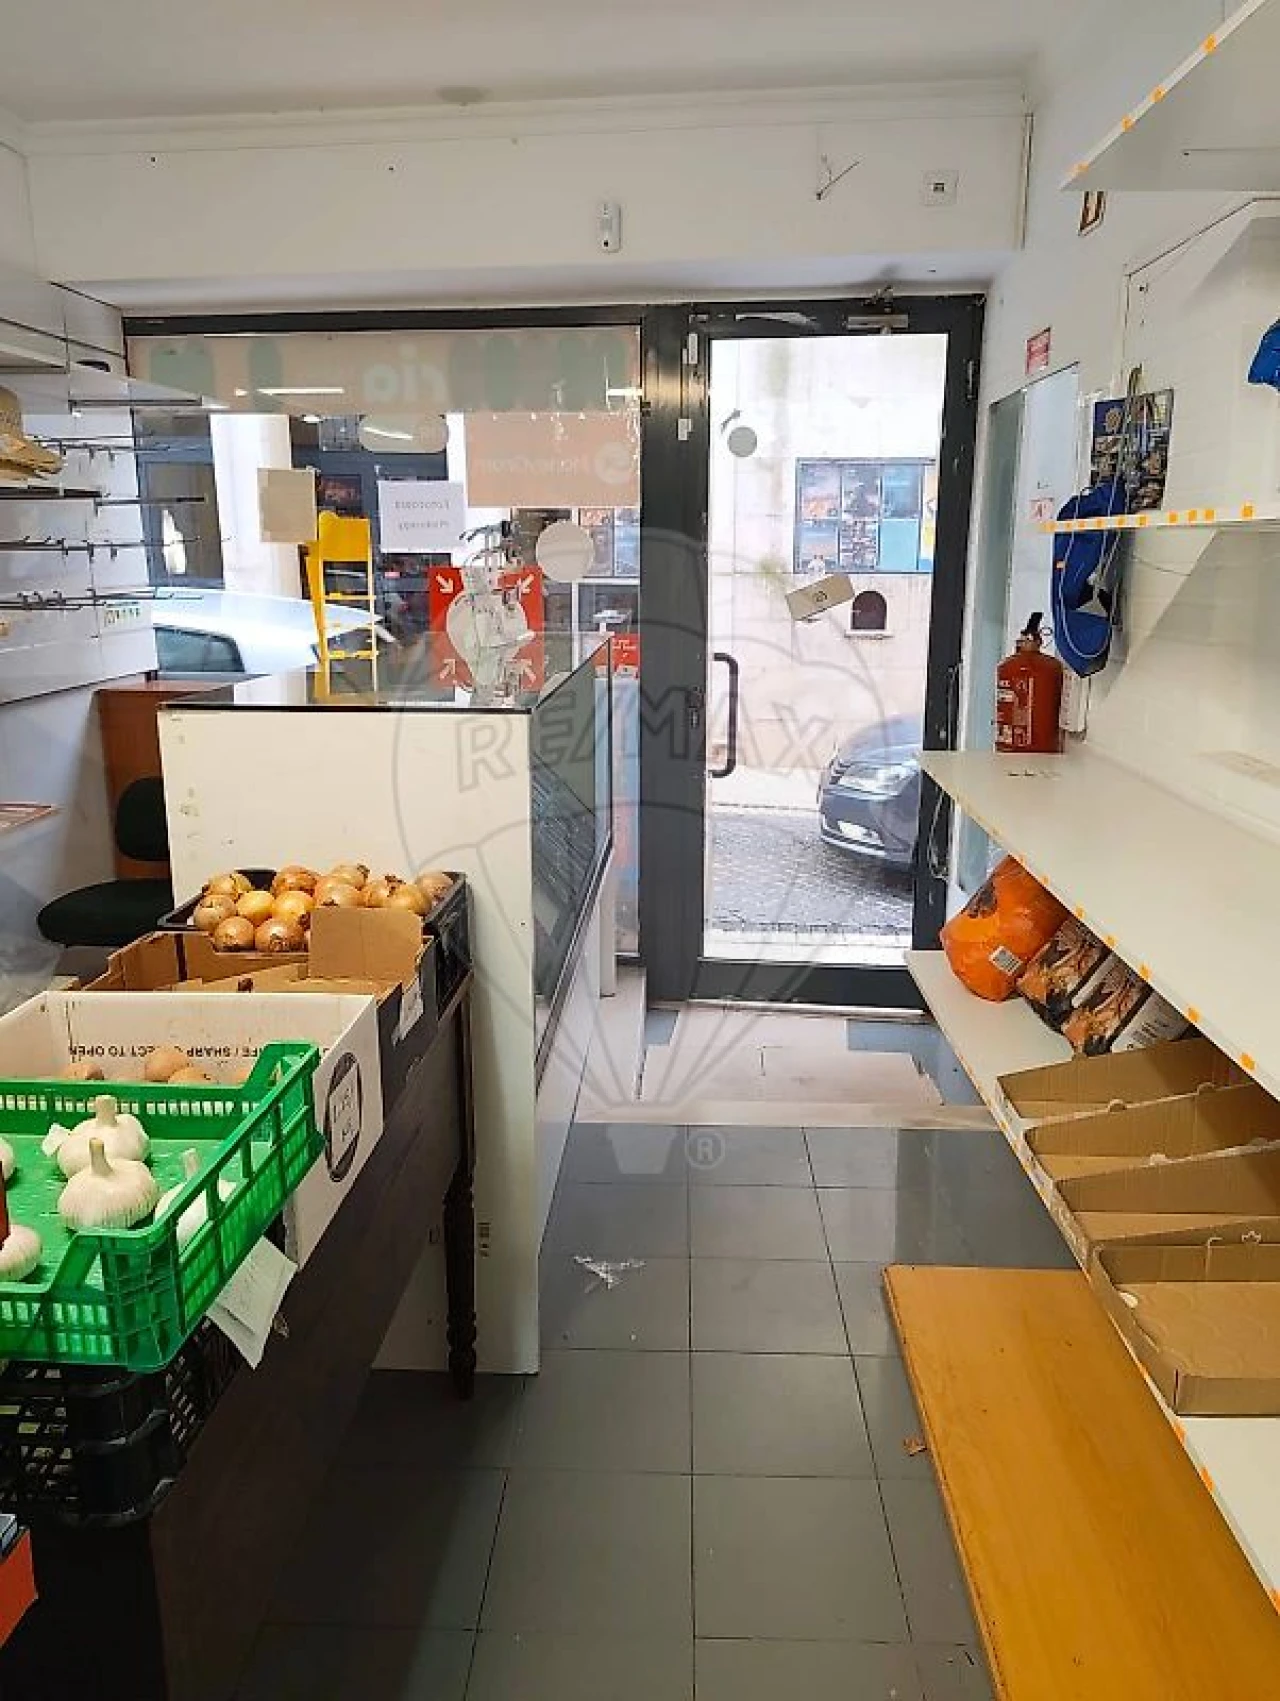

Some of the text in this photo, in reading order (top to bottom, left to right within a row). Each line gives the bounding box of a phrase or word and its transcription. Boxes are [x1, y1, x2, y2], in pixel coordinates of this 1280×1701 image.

[68, 1045, 105, 1057] OPEN
[108, 1045, 125, 1057] TO
[187, 1046, 231, 1058] SHARP
